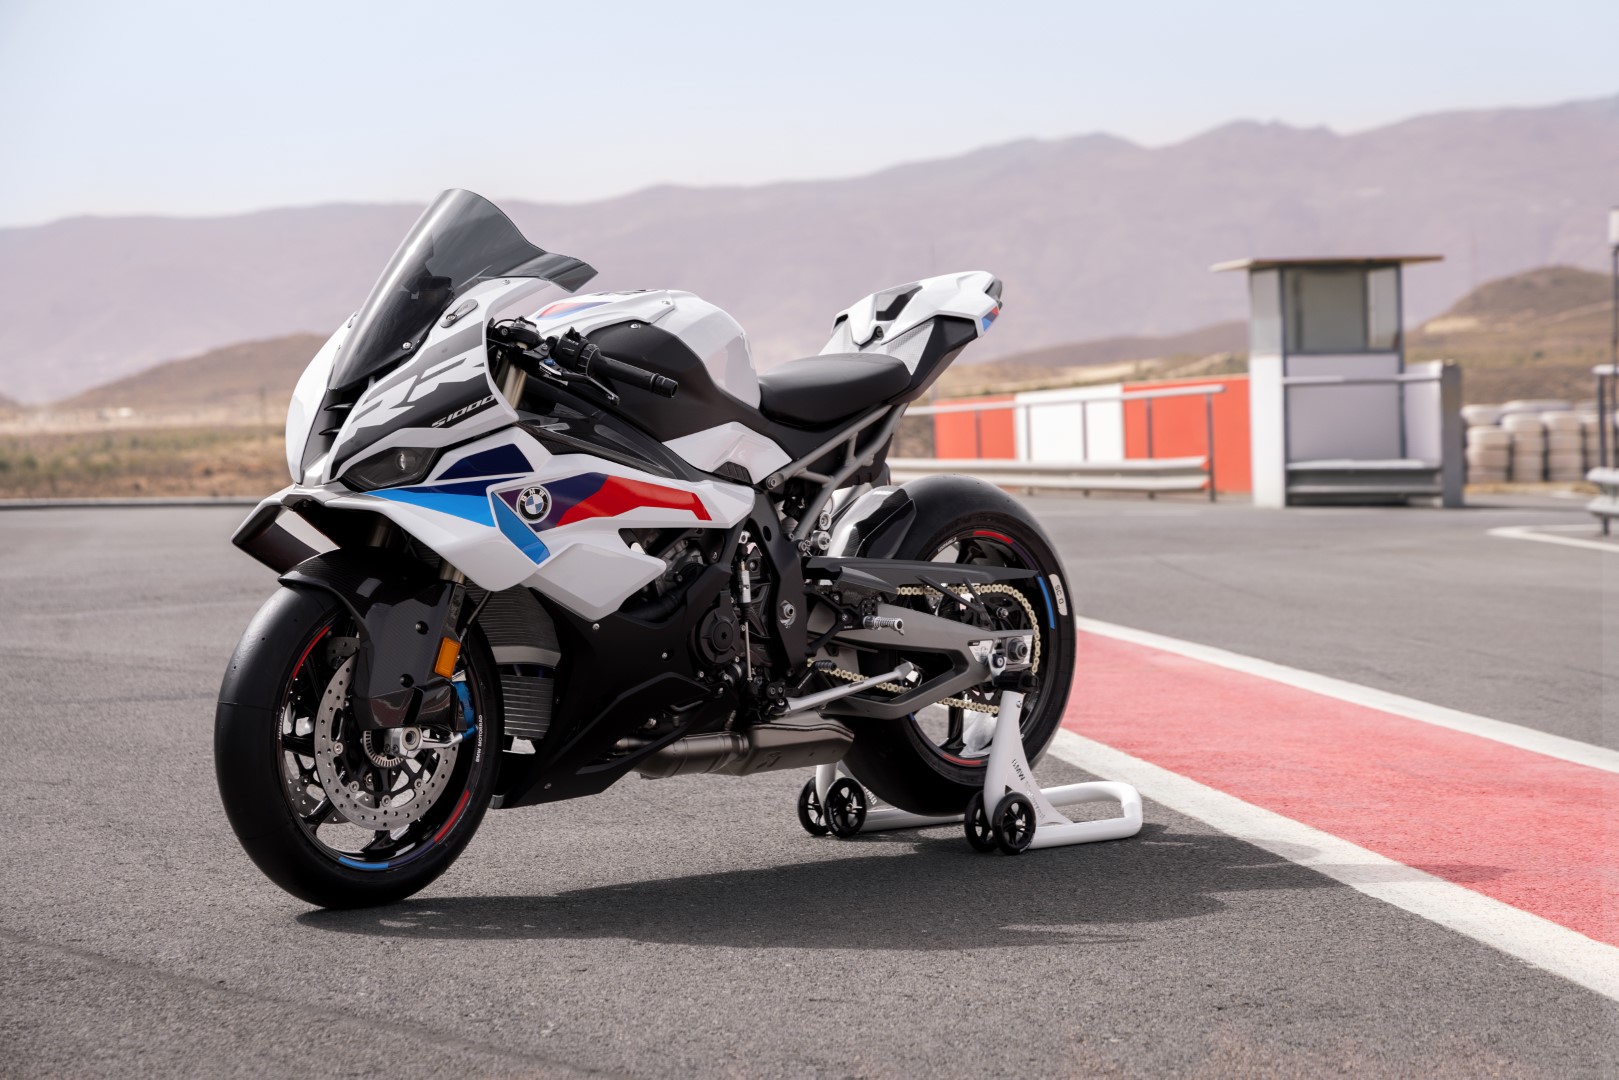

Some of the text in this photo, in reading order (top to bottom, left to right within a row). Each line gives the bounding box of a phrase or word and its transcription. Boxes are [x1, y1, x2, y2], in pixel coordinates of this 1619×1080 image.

[432, 395, 495, 428] S1000
[520, 487, 547, 502] BMW
[1011, 758, 1026, 781] BMW
